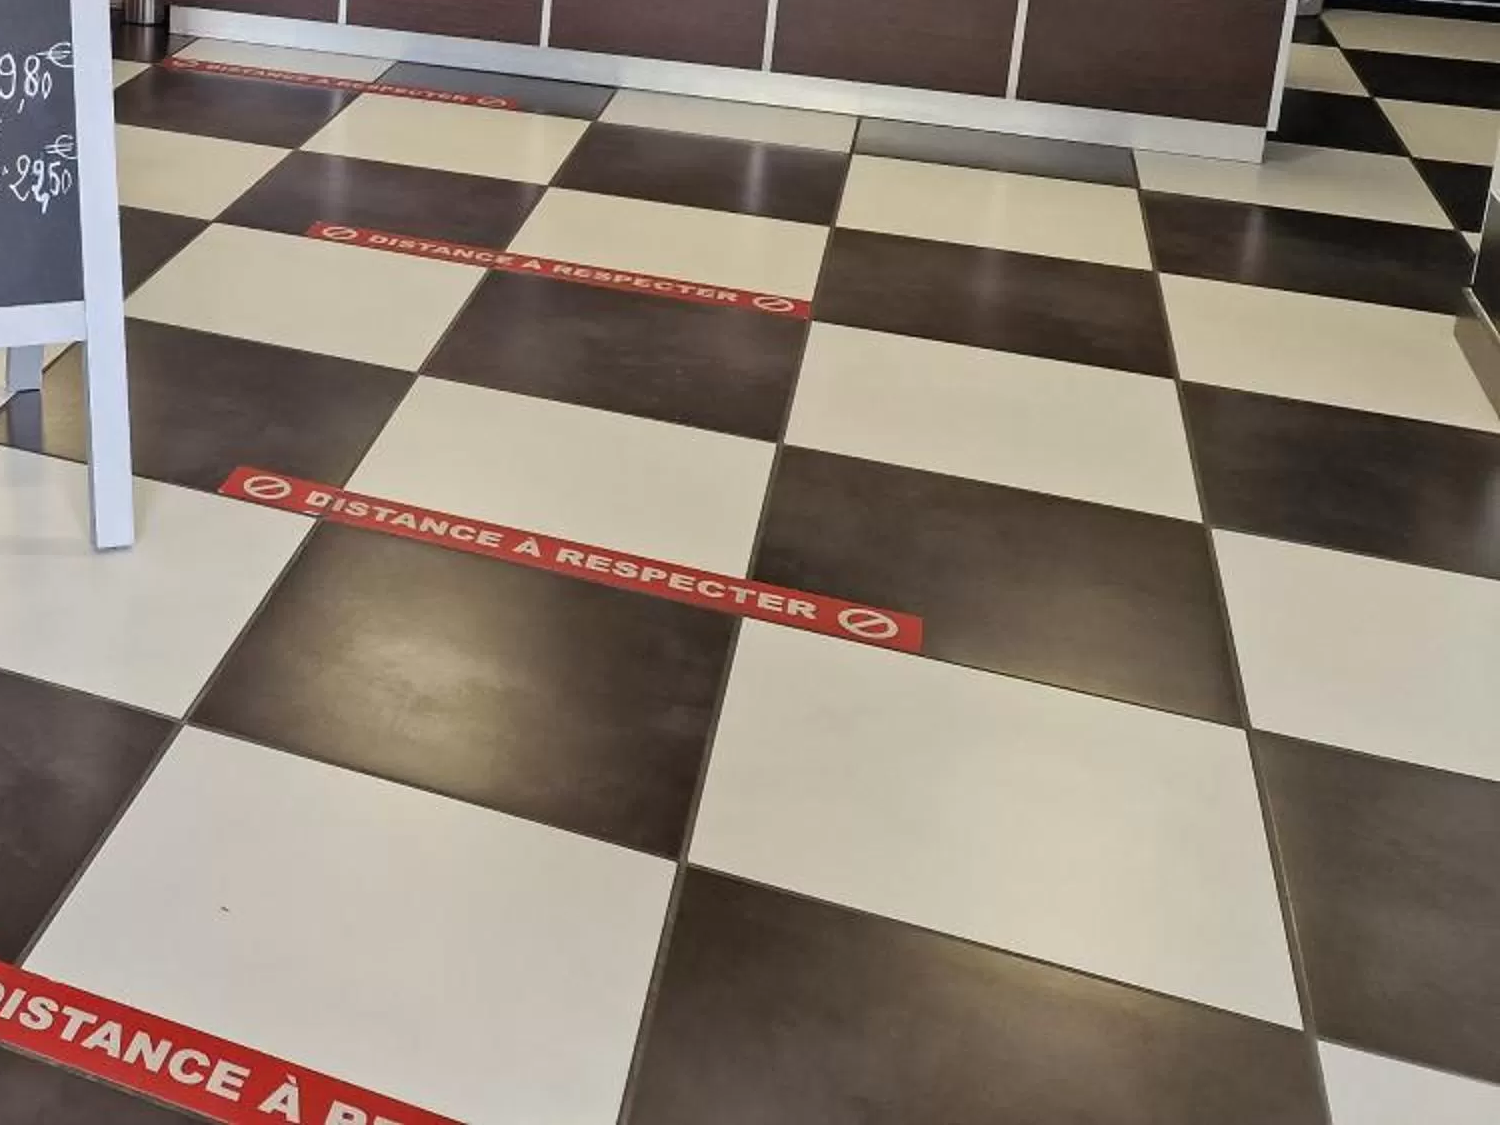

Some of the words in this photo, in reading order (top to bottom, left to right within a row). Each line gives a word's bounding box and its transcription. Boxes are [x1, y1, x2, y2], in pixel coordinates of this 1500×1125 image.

[367, 233, 513, 267] DISTANCE
[552, 263, 739, 303] RESPECTER
[304, 490, 505, 548] DISTANCE
[510, 535, 543, 559] À
[556, 548, 819, 621] RESPECTER
[258, 1074, 301, 1124] À
